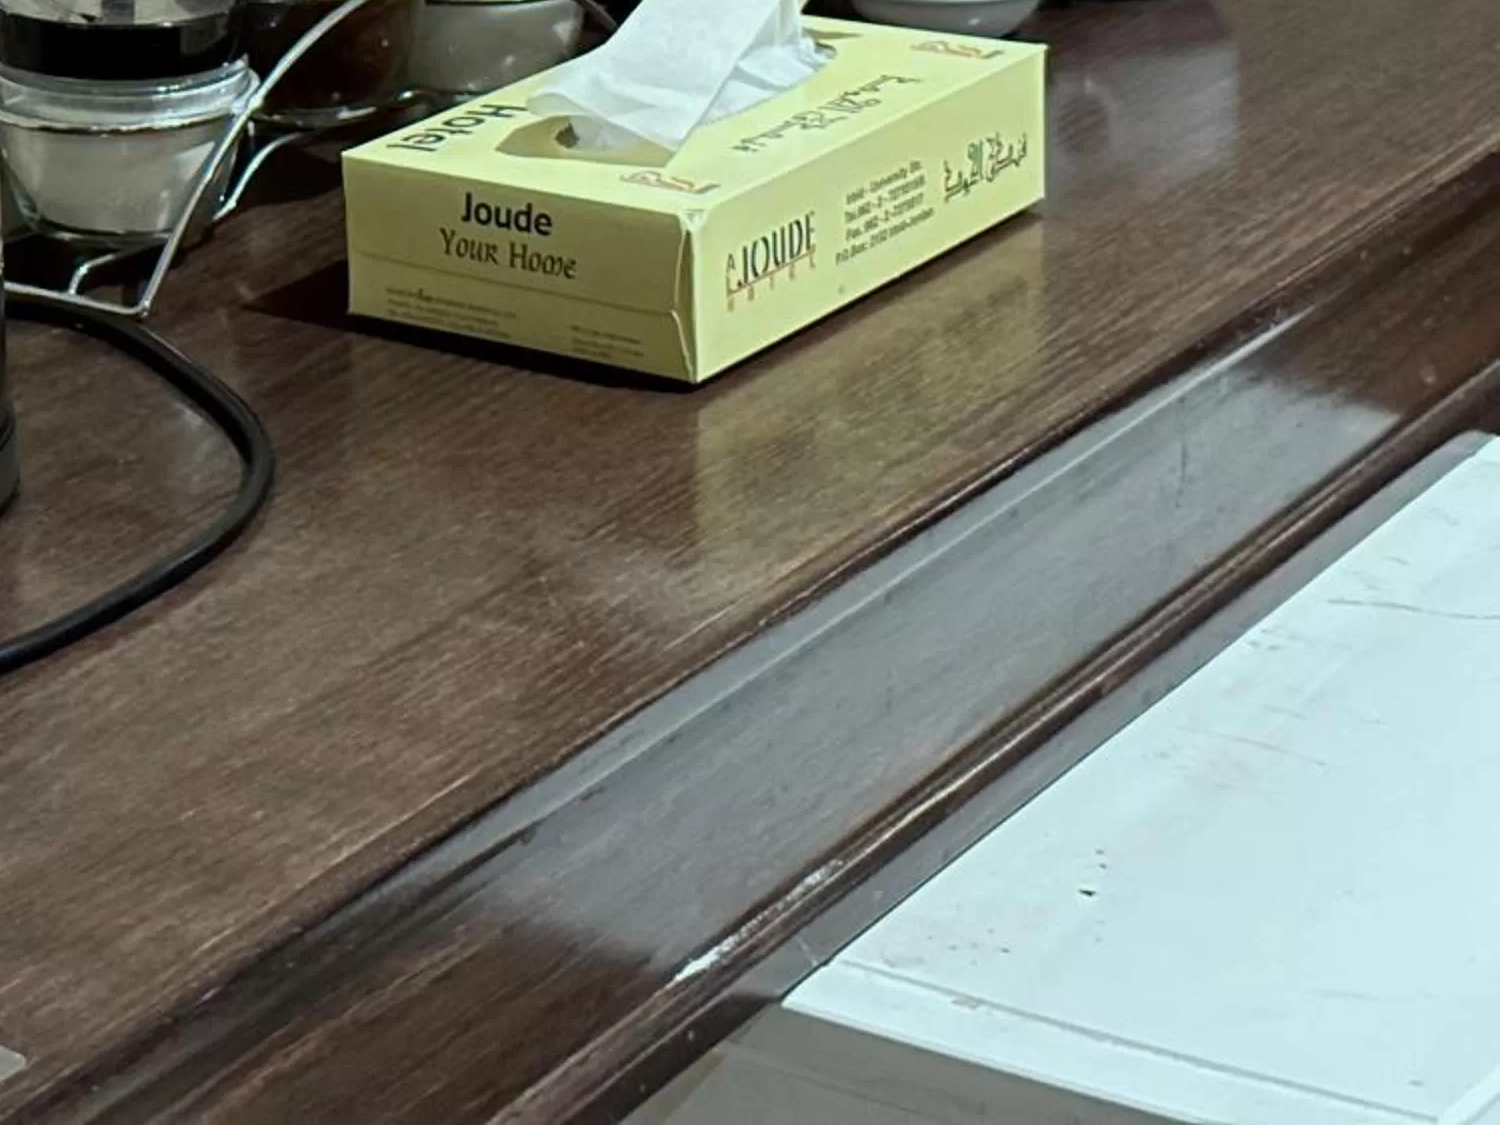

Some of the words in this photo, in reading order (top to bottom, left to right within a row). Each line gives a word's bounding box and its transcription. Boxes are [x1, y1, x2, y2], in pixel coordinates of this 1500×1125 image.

[385, 102, 528, 152] Hotel
[461, 191, 552, 236] Joude
[509, 240, 577, 279] Home
